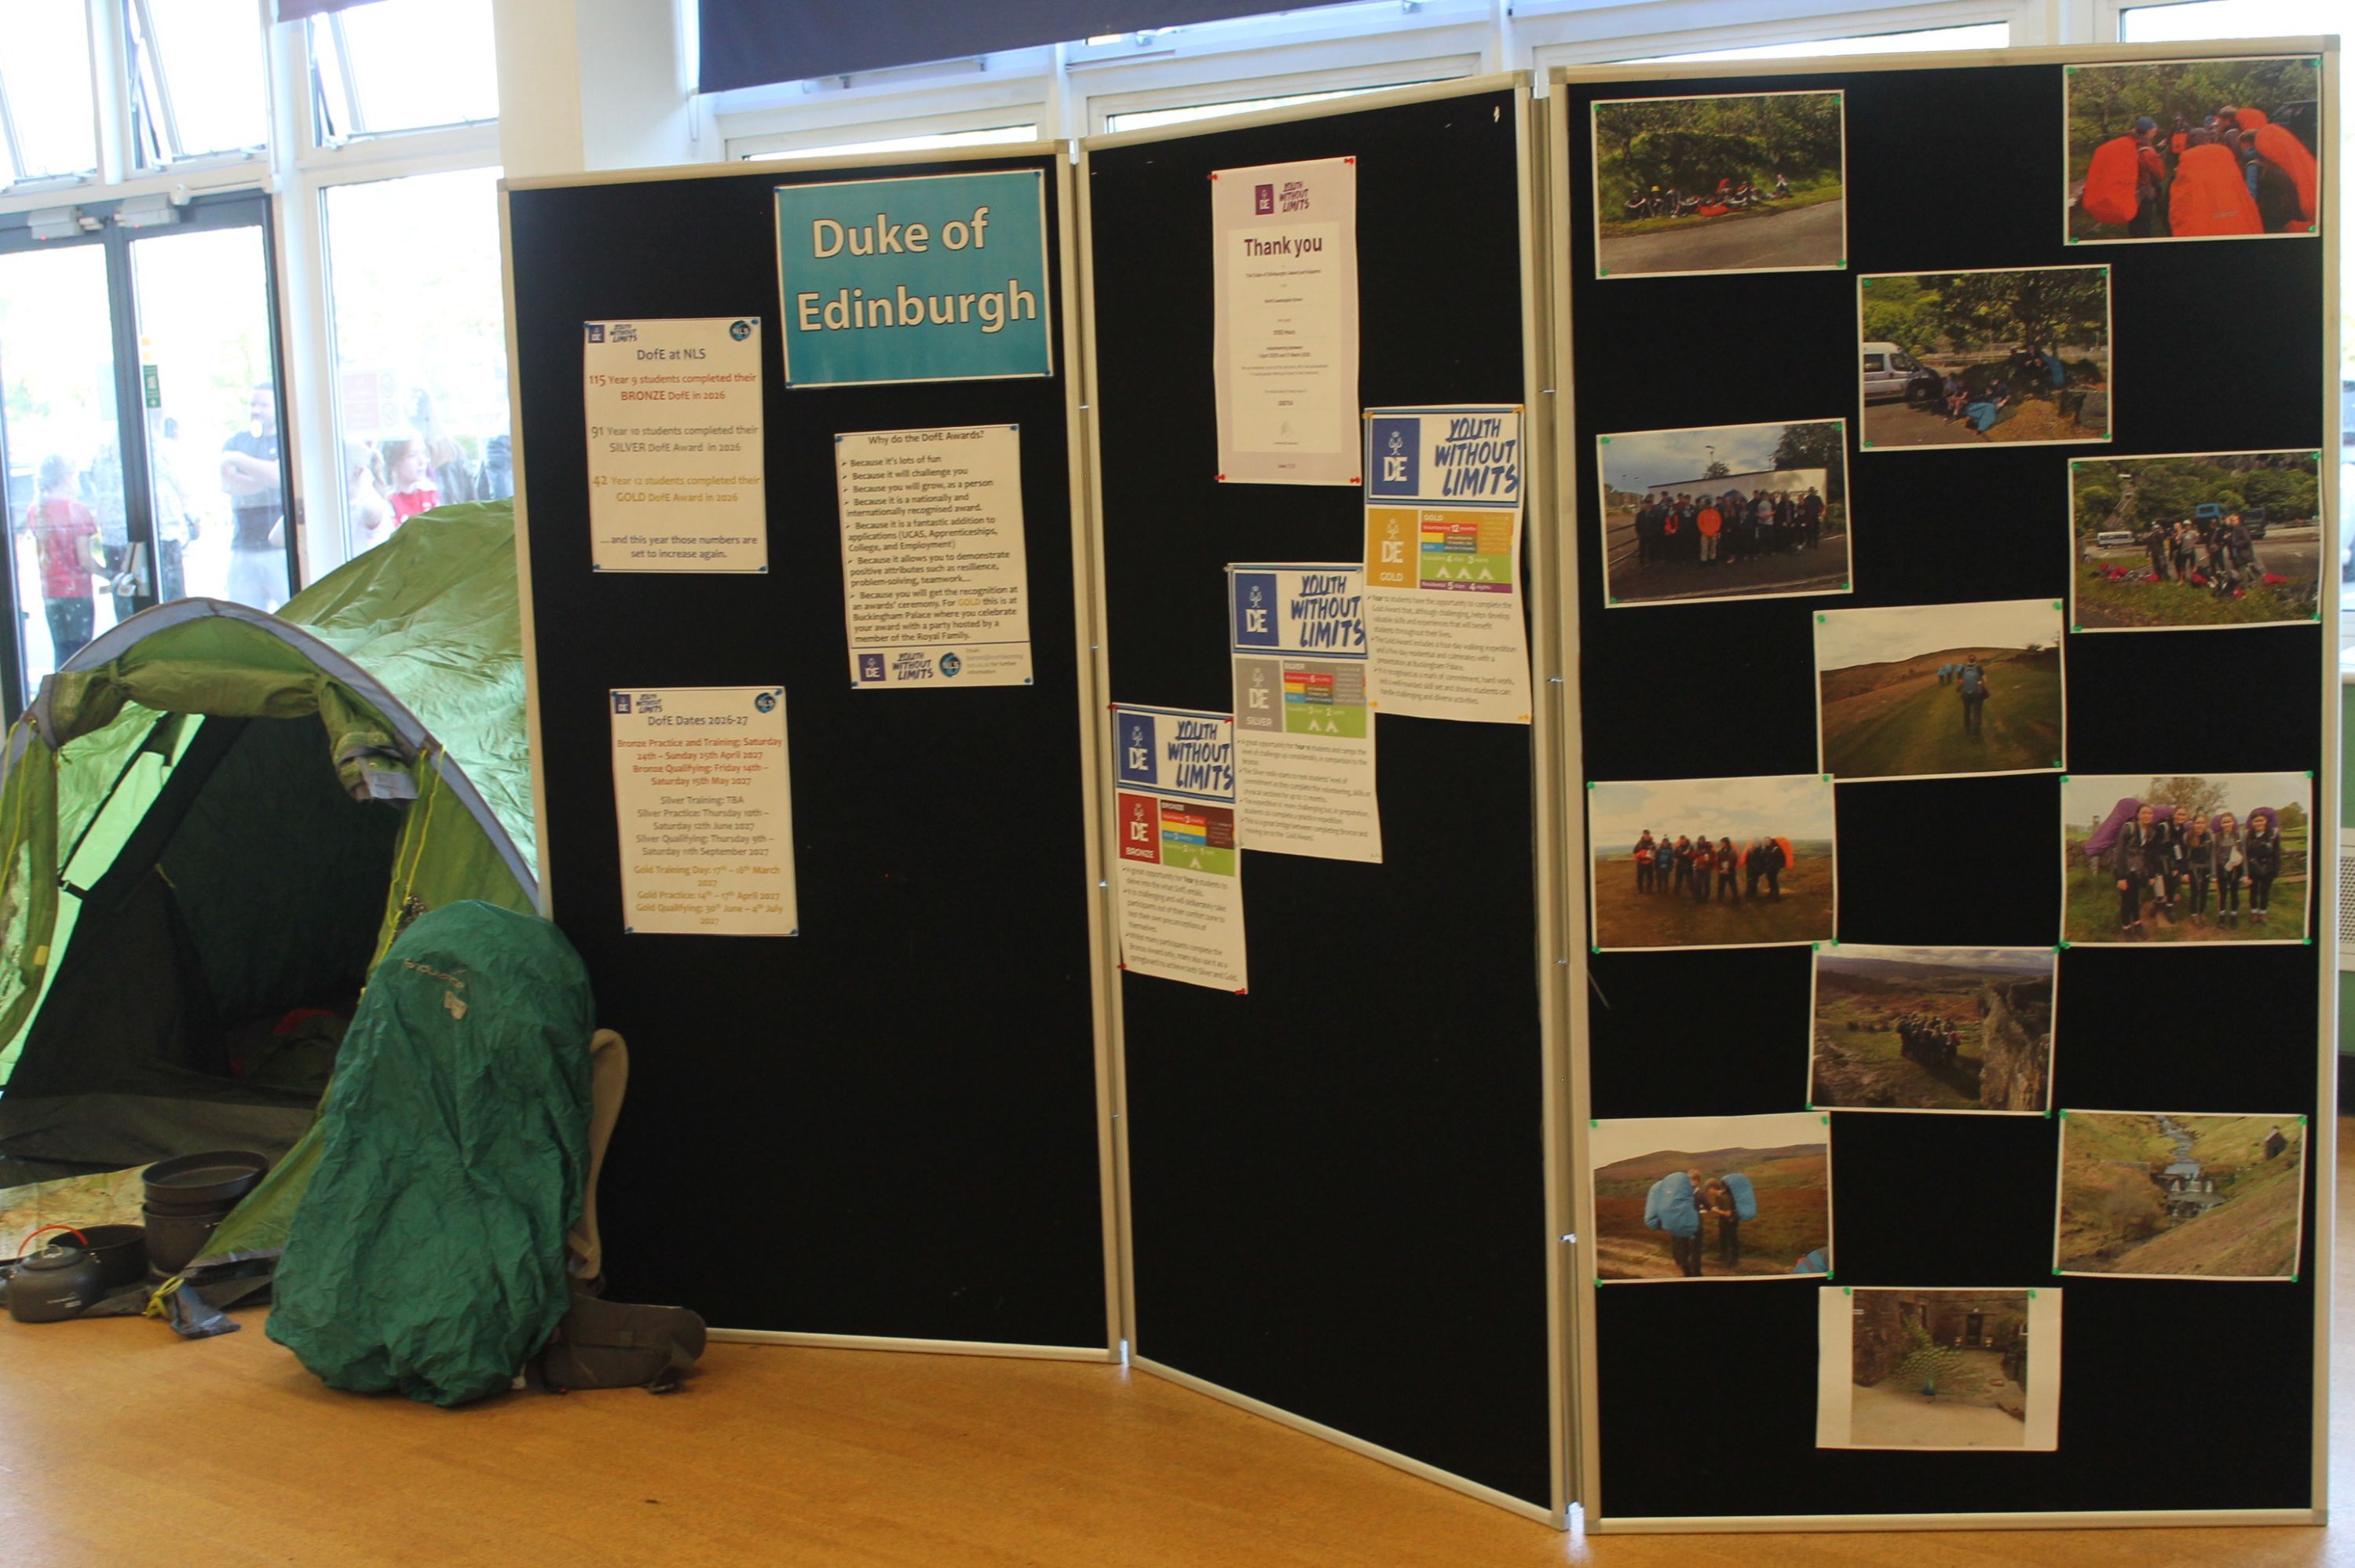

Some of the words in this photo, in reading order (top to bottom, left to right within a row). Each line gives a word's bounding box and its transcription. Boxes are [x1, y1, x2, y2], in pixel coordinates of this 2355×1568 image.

[1279, 188, 1310, 202] WITHOUT
[1282, 199, 1310, 213] LIMITS
[811, 213, 930, 259] Duke
[942, 206, 989, 250] of
[1244, 236, 1291, 257] Thank
[1295, 237, 1322, 258] you
[796, 279, 1037, 334] Edinburgh
[637, 348, 665, 360] DofE
[668, 349, 680, 360] at
[683, 348, 706, 360] NLS
[589, 375, 606, 386] 115
[608, 375, 629, 384] Year
[631, 376, 638, 386] 9
[639, 374, 680, 383] students
[682, 373, 732, 385] completed
[733, 372, 756, 382] their
[620, 390, 666, 400] BRONZE
[667, 390, 690, 400] DofE
[703, 390, 726, 400] 2026
[591, 426, 603, 438] 91
[606, 426, 628, 435] Year
[642, 426, 682, 435] students
[684, 425, 733, 437] completed
[735, 425, 758, 434] their
[1446, 418, 1501, 442] YOUTH
[868, 435, 889, 446] Why
[890, 434, 902, 443] do
[904, 433, 920, 442] the
[921, 432, 943, 441] DofE
[945, 429, 984, 440] Awards?
[609, 442, 645, 452] SILVER
[648, 443, 671, 451] DofE
[672, 443, 703, 451] Award
[707, 442, 717, 451] in
[719, 442, 741, 451] 2026
[1435, 439, 1516, 467] WITHOUT
[850, 458, 883, 466] Because
[884, 456, 898, 465] it's
[916, 455, 926, 463] of
[927, 454, 942, 462] fun
[852, 471, 885, 480] Because
[912, 467, 951, 478] challenge
[953, 468, 968, 477] you
[1442, 464, 1519, 496] LIMITS
[592, 476, 608, 487] 42
[644, 476, 685, 484] students
[686, 476, 737, 486] completed
[737, 475, 760, 484] their
[853, 484, 886, 492] Because
[964, 480, 993, 488] person
[616, 492, 646, 502] GOLD
[648, 493, 671, 502] DofE
[672, 493, 704, 502] Award
[704, 493, 714, 502] in
[847, 506, 905, 518] internationally
[907, 505, 953, 516] recognised
[954, 503, 982, 512] award.
[629, 535, 646, 543] this
[649, 537, 669, 546] year
[671, 535, 697, 544] those
[698, 535, 740, 544] numbers
[699, 550, 727, 561] again.
[858, 556, 890, 565] Because
[900, 554, 927, 562] allows
[956, 550, 1010, 560] demonstrate
[850, 567, 882, 576] positive
[883, 565, 924, 574] attributes
[1380, 572, 1404, 582] GOLD
[1299, 575, 1347, 598] YOUTH
[1291, 595, 1361, 620] WITHOUT
[853, 612, 903, 622] Buckingham
[933, 609, 959, 618] where
[978, 608, 1017, 616] celebrate
[916, 632, 940, 641] Royal
[942, 630, 970, 641] Family.
[1300, 619, 1365, 648] LIMITS
[892, 660, 931, 671] WITHOUT
[898, 668, 934, 681] LIMITS
[648, 715, 673, 726] DofE
[675, 715, 706, 725] Dates
[1246, 716, 1273, 727] SILVER
[1176, 721, 1218, 740] YOUTH
[617, 739, 647, 747] Bronze
[648, 738, 683, 747] Practice
[703, 737, 741, 748] Training:
[743, 736, 781, 747] Saturday
[1168, 742, 1230, 763] WITHOUT
[651, 777, 690, 787] Saturday
[711, 777, 730, 786] May
[1176, 764, 1234, 791] LIMITS
[686, 795, 725, 806] Training:
[1125, 846, 1155, 859] BRONZE
